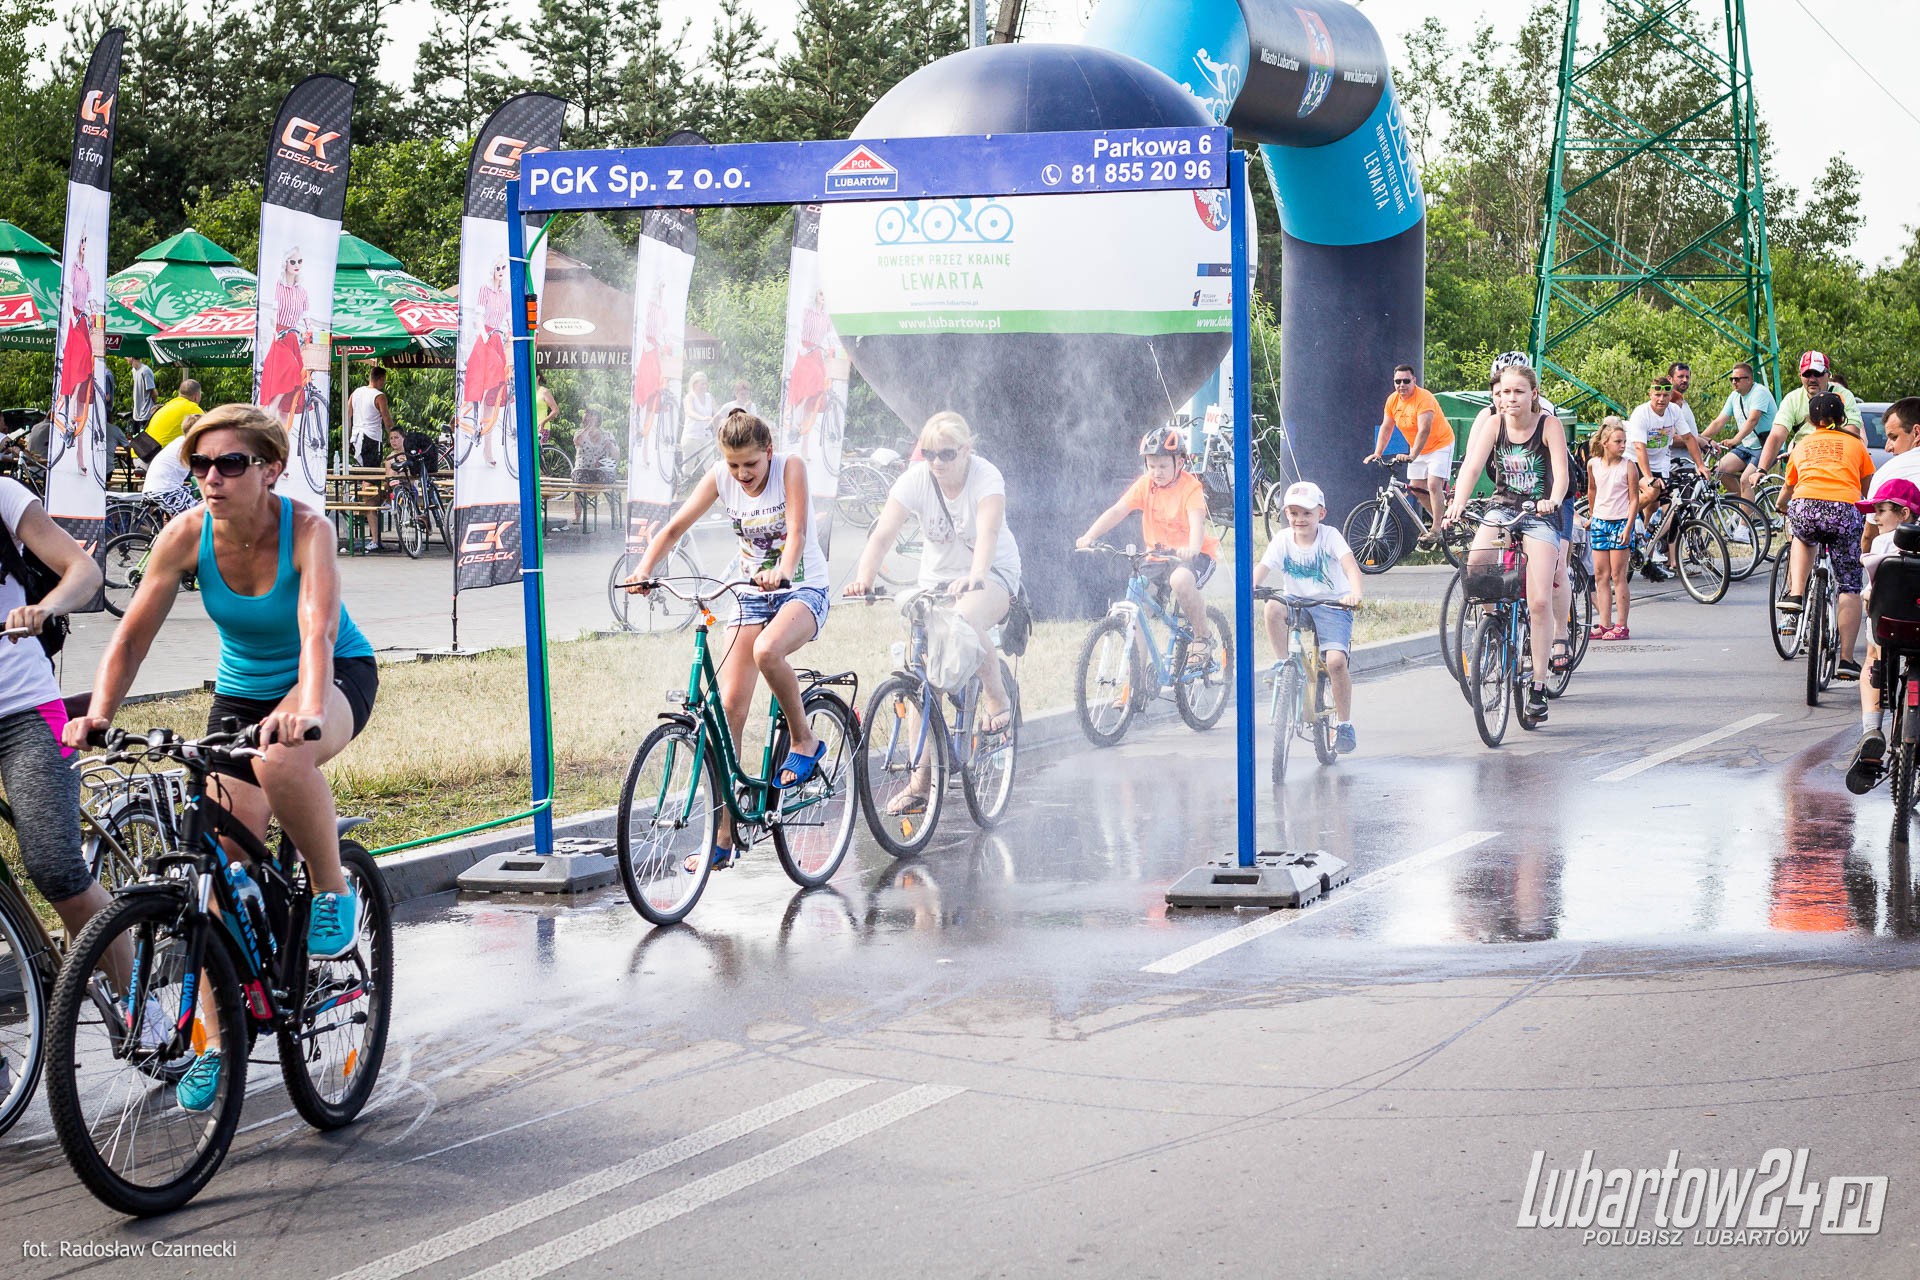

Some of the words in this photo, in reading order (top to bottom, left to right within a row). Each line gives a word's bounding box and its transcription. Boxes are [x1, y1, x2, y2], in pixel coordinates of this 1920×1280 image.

[1260, 47, 1278, 66] Miasto
[281, 116, 341, 160] CK
[1093, 136, 1192, 159] Parkowa
[1199, 134, 1213, 155] 6
[277, 147, 340, 174] COSSACK
[850, 159, 873, 170] PGK
[1071, 164, 1096, 185] 81
[1104, 162, 1145, 184] 855
[1150, 160, 1178, 182] 20
[1184, 159, 1213, 181] 96
[277, 171, 292, 186] Fit
[290, 174, 308, 190] for
[303, 183, 324, 196] you
[529, 165, 600, 196] PGK
[607, 164, 658, 199] Sp.
[666, 168, 685, 191] z
[692, 167, 752, 191] o.o.
[833, 175, 890, 188] LUBARTÓW
[1363, 150, 1391, 211] LEWARTA
[480, 186, 496, 198] Fit
[495, 185, 508, 201] fo
[878, 254, 925, 268] ROWEREM
[929, 253, 963, 267] PRZEZ
[967, 252, 1012, 267] KRAINĘ
[901, 271, 984, 291] LEWARTA
[399, 306, 458, 330] PER
[898, 315, 1002, 331] www.lubartow.pl
[536, 351, 552, 365] DY
[555, 351, 578, 365] JAK
[1206, 413, 1220, 425] WC
[459, 520, 516, 554] CK
[182, 972, 196, 1001] MTB
